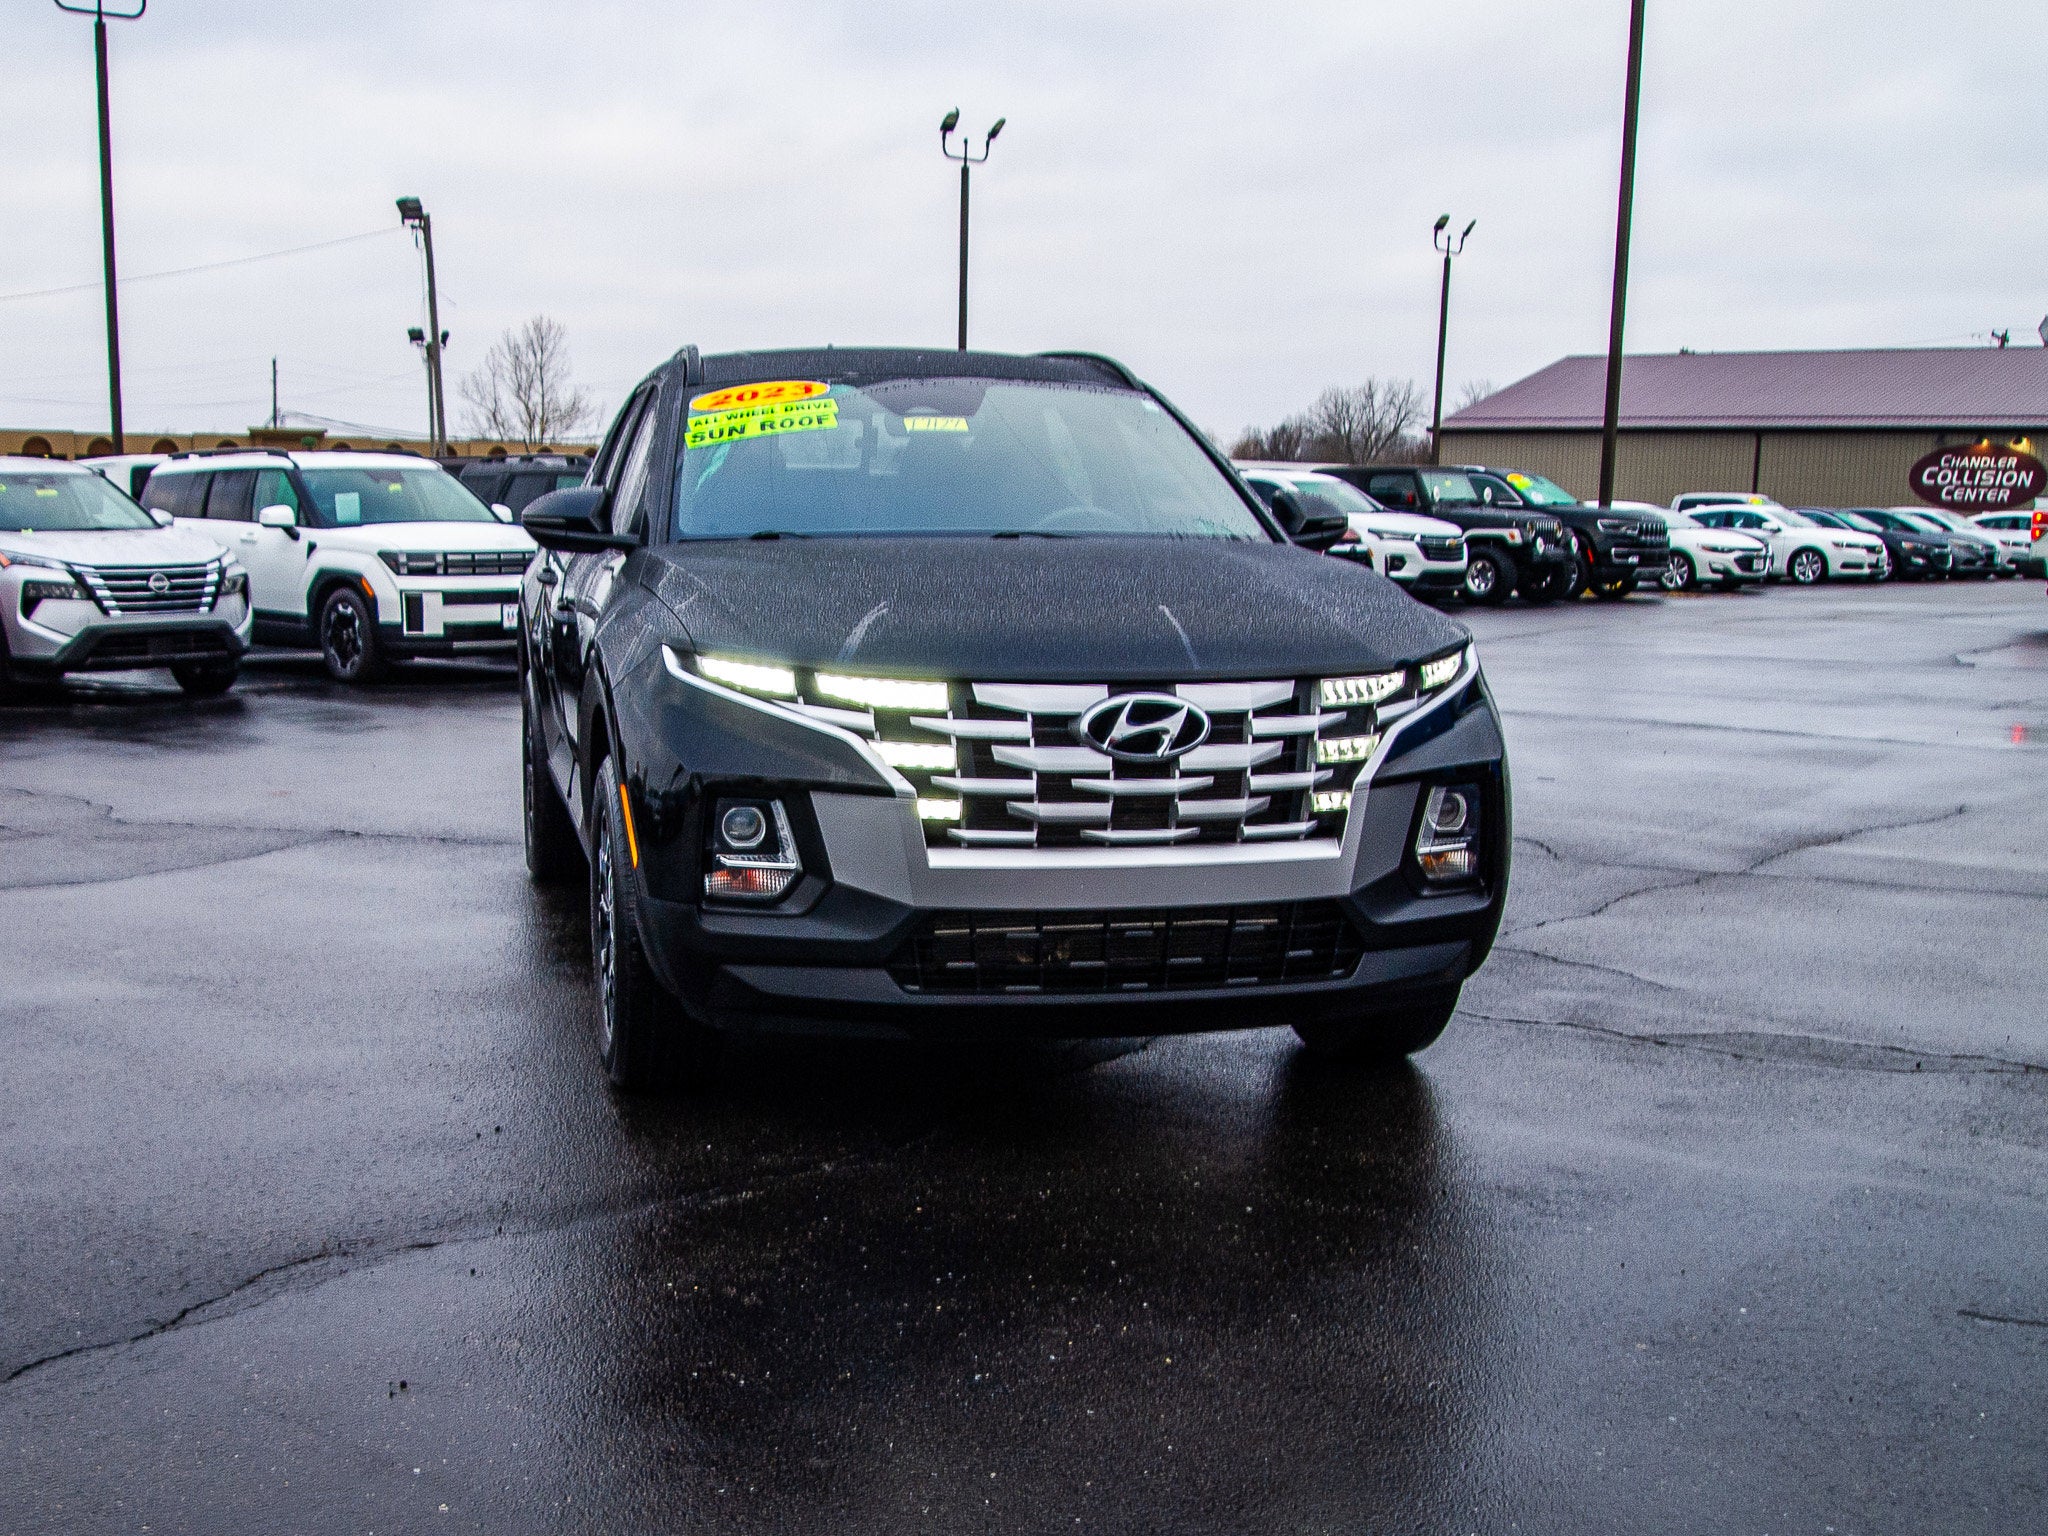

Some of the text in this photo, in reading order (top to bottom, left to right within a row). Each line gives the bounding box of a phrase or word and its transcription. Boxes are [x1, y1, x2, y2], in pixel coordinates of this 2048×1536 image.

[707, 384, 814, 407] 2023
[694, 401, 833, 427] ALL WHEEL DRIVE
[691, 414, 831, 444] SUN ROOF
[1941, 454, 2018, 469] CHANDLER
[1922, 466, 2034, 488] COLLISION
[1941, 485, 2011, 503] CENTER
